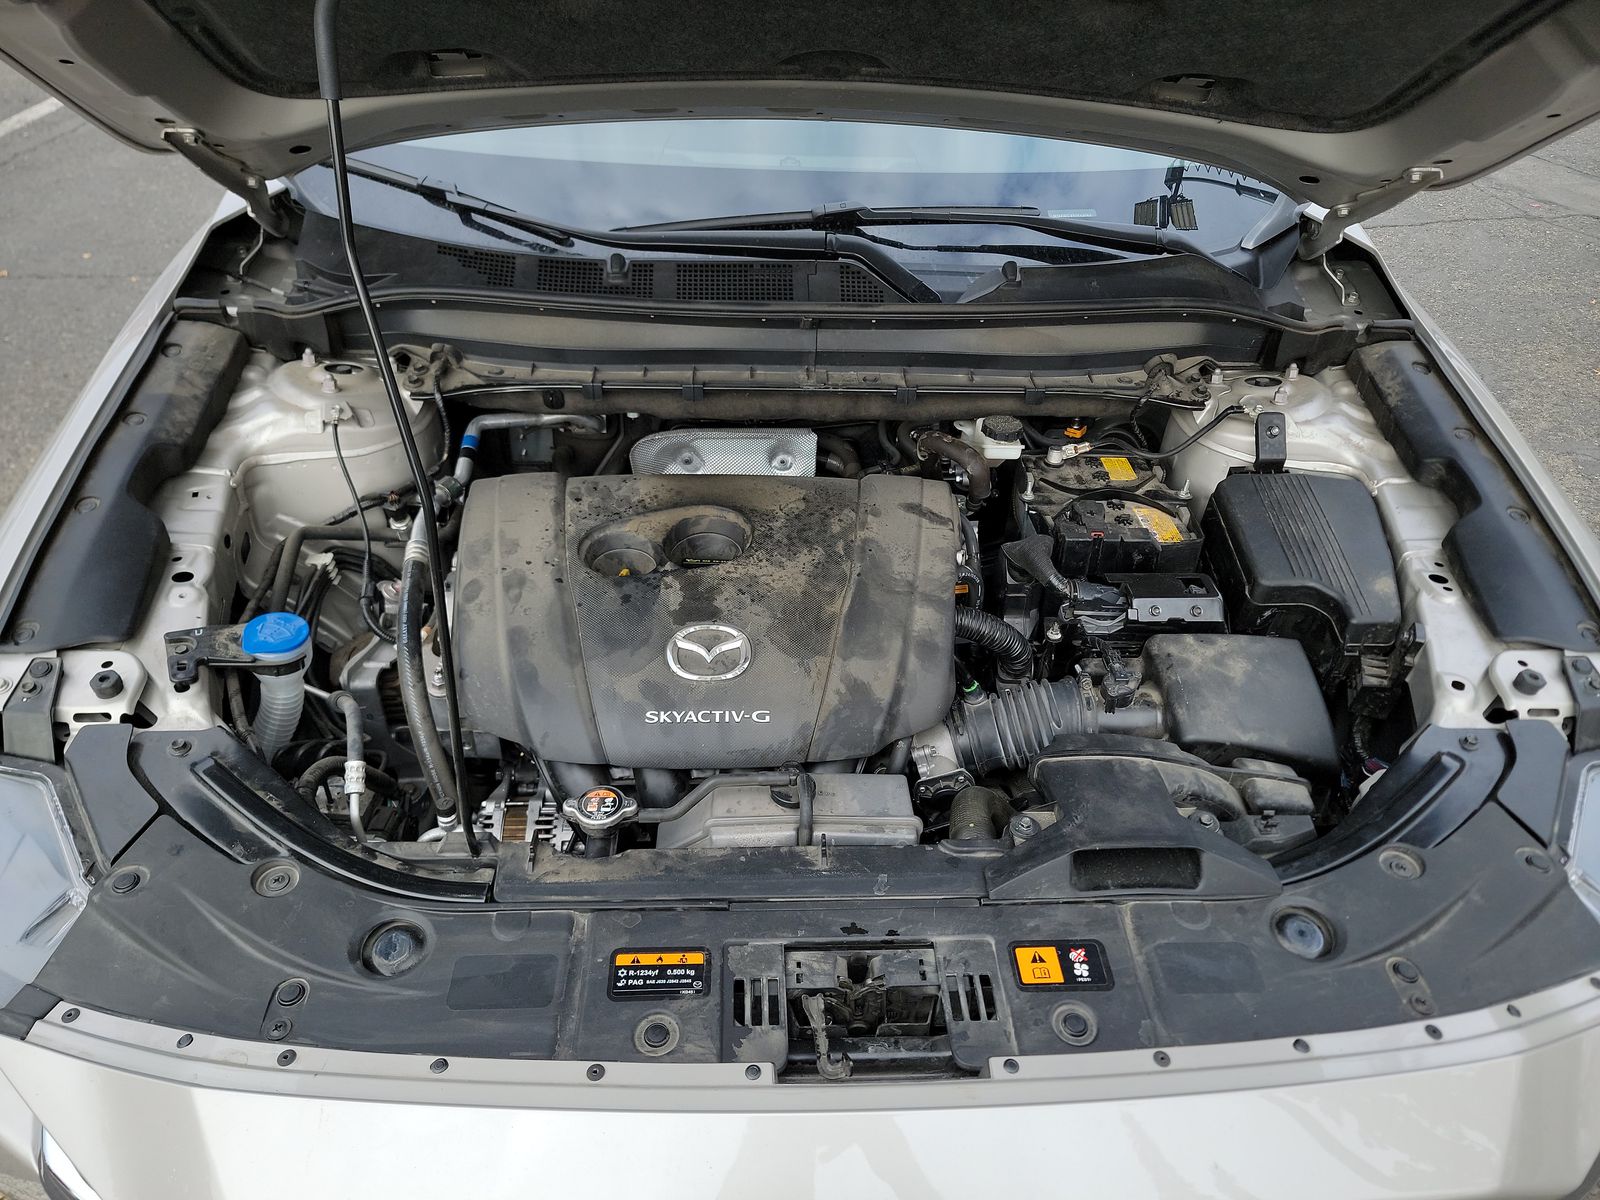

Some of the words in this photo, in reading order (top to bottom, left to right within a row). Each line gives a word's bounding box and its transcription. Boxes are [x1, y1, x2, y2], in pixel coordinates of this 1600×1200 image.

[644, 710, 771, 723] SKYACTIV-G
[628, 969, 659, 977] R-1234yf
[686, 968, 695, 976] kg
